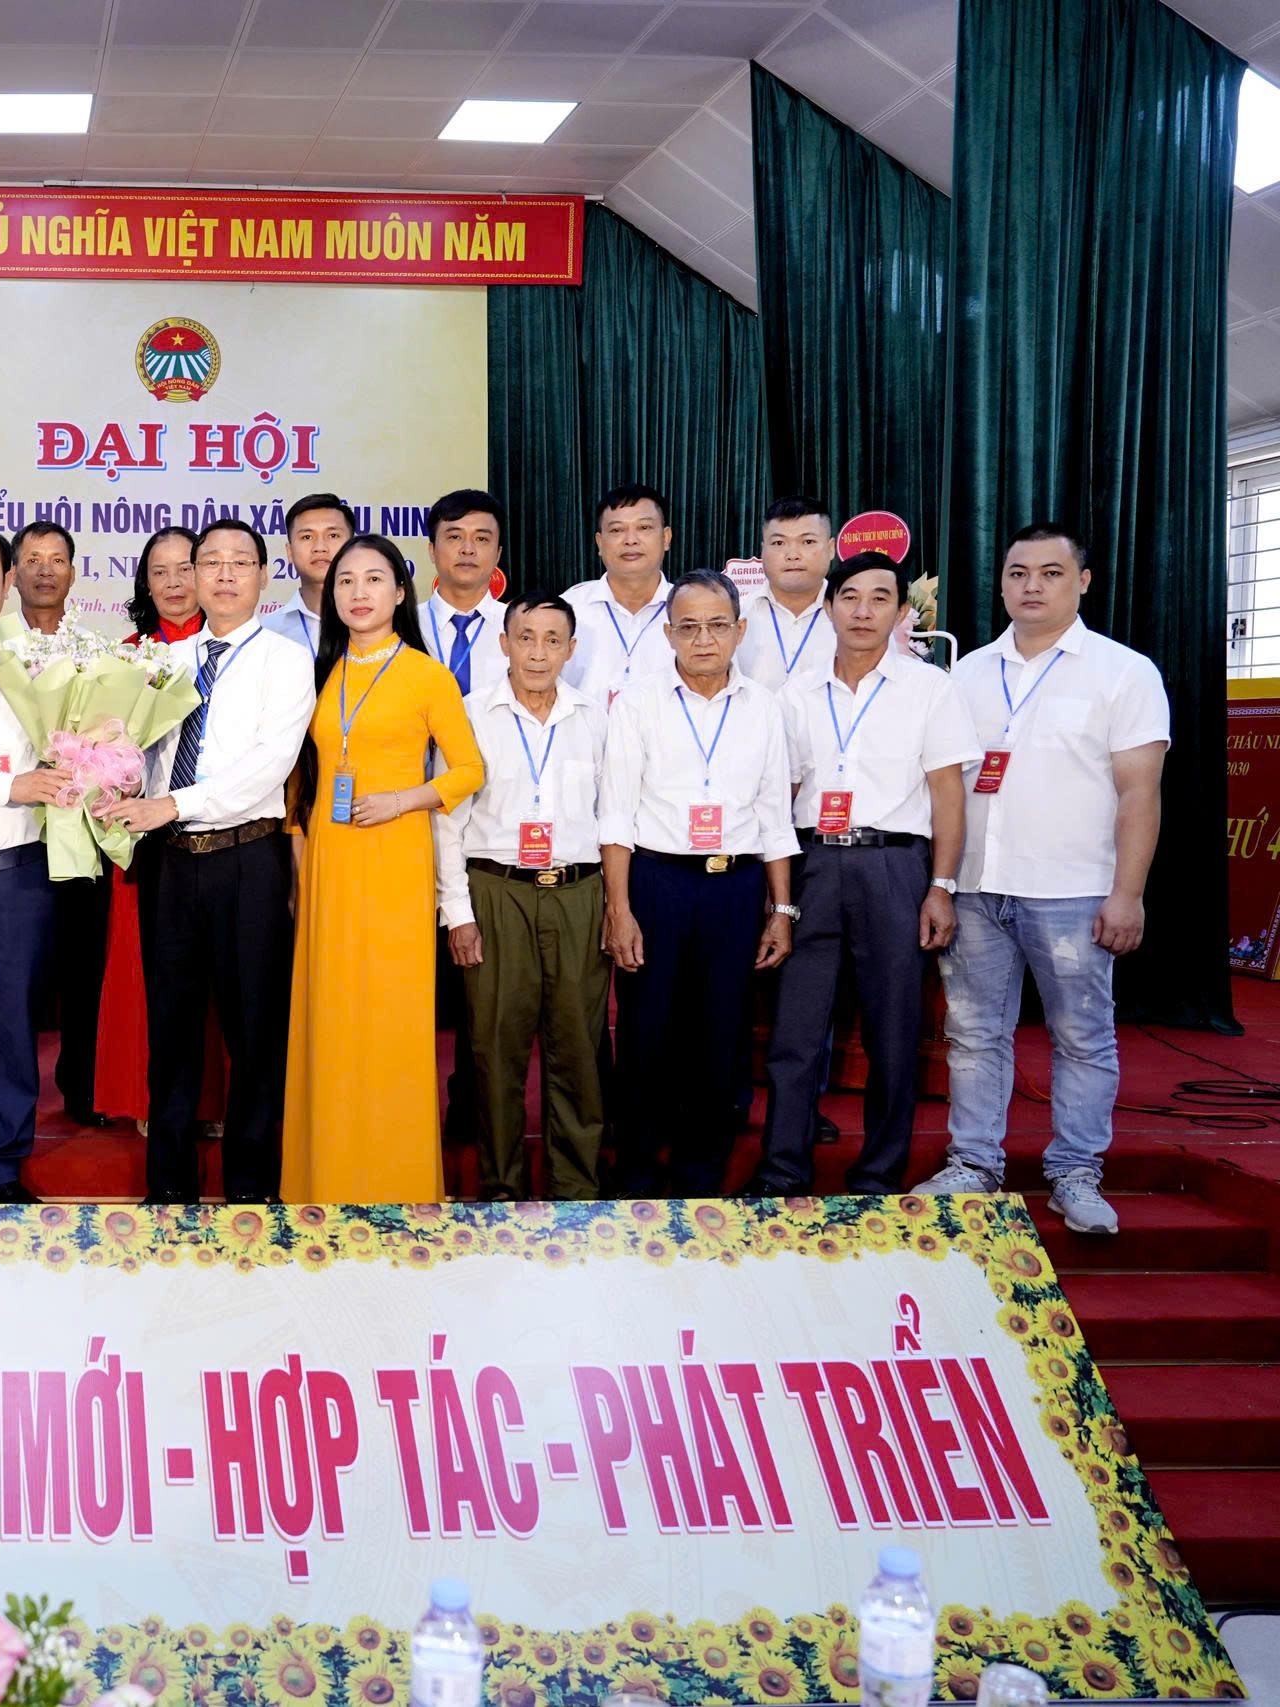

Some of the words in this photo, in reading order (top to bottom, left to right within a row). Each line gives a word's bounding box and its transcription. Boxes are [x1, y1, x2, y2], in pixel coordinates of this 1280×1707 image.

[21, 208, 132, 257] NGHĨA
[144, 209, 219, 266] VIỆT
[230, 219, 313, 259] NAM
[325, 212, 432, 261] MUÔN
[443, 213, 526, 262] NĂM
[37, 422, 166, 481] ĐẠI
[189, 411, 319, 483] HỘI
[92, 496, 172, 533] NÔNG
[249, 498, 288, 535] XÃ
[381, 506, 431, 537] NIN
[272, 558, 301, 580] 20
[731, 567, 765, 576] AGRIBA
[1226, 731, 1263, 750] CHÂU
[1227, 805, 1269, 859] HỨ
[0, 1336, 153, 1538] MỚI
[204, 1354, 360, 1577] HỢP
[376, 1334, 539, 1534] TÁC
[572, 1329, 793, 1530] PHÁT
[781, 1293, 1050, 1526] TRIỂN
